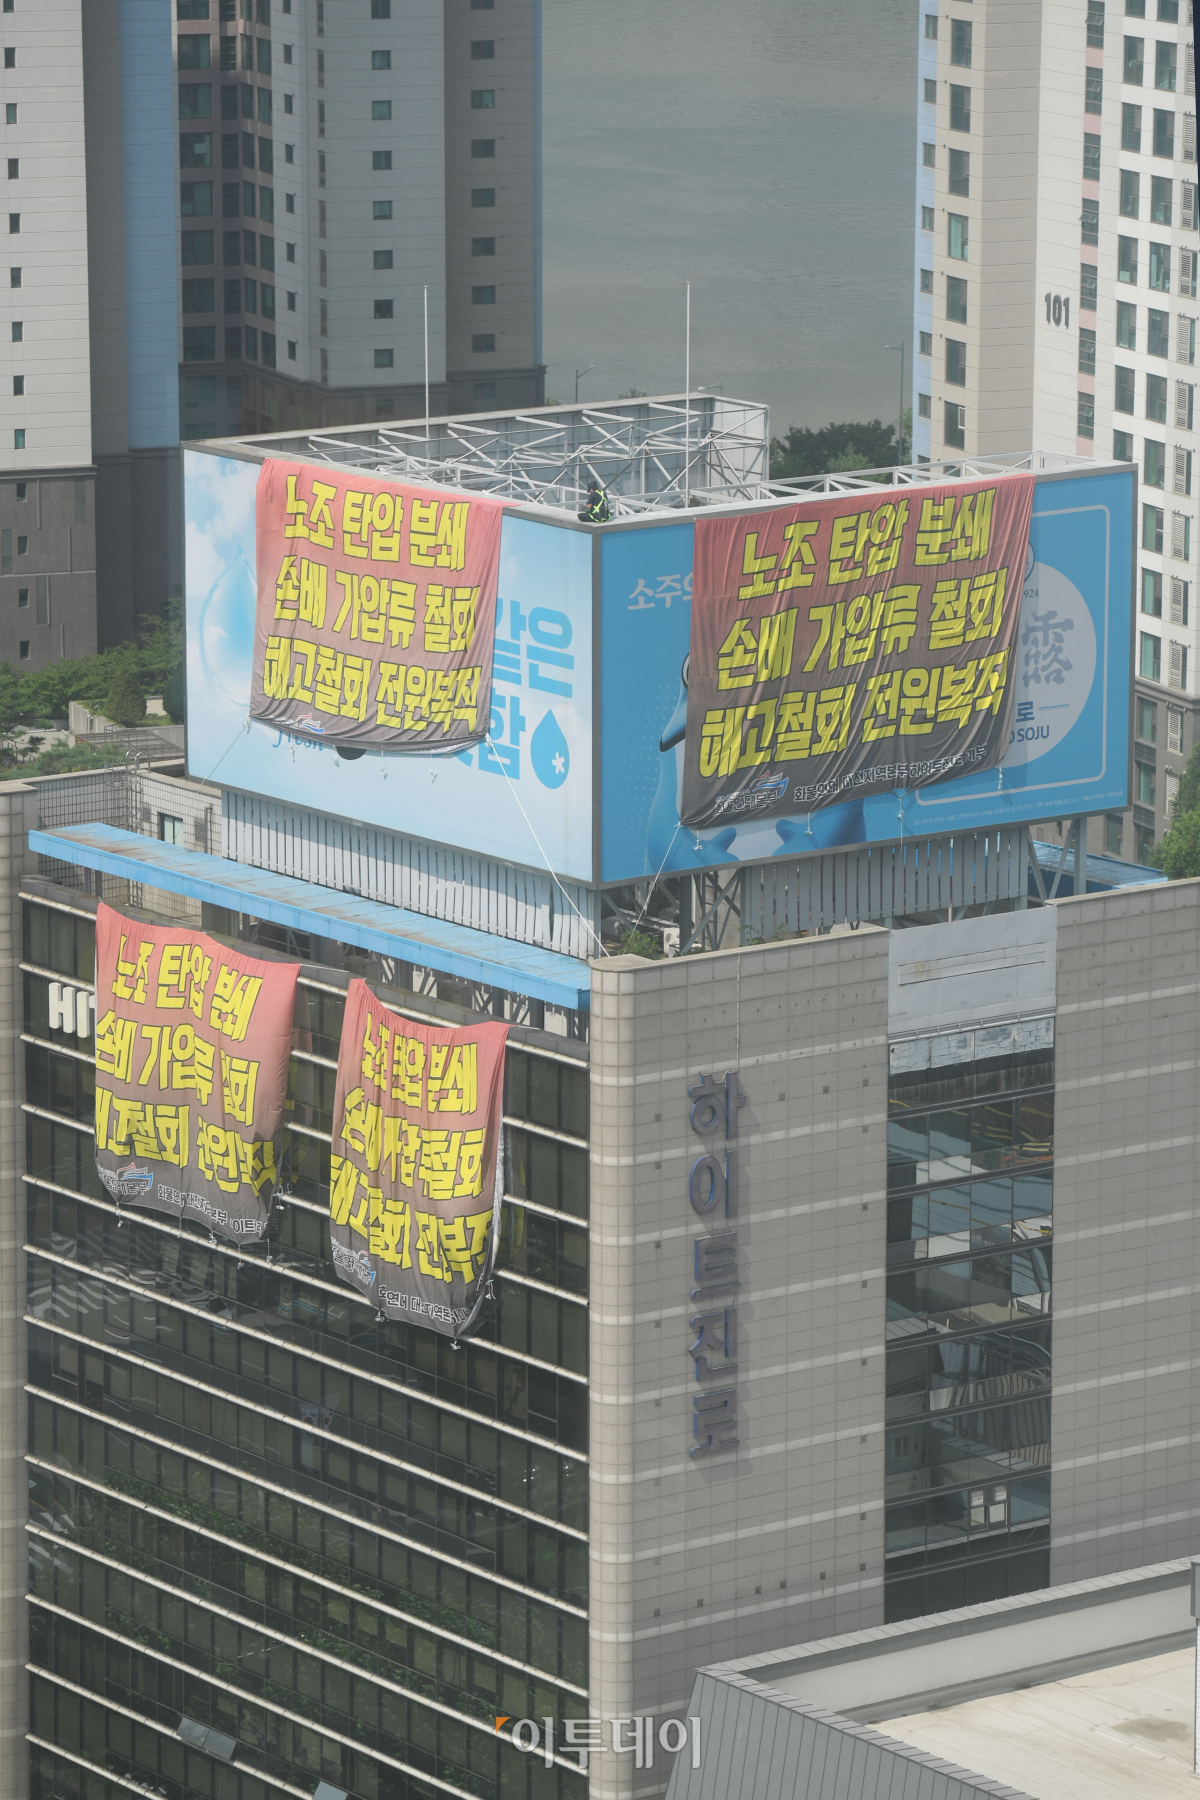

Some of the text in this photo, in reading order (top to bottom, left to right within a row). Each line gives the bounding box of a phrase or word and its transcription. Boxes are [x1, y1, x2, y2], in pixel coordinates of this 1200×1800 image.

[1045, 292, 1070, 329] 101
[285, 475, 470, 572] 노조 탄압 분쇄
[738, 488, 996, 600] 노조 탄압 분쇄
[274, 555, 480, 653] 손배 가압류 철회
[717, 567, 1009, 691] 손배 가압류 철회
[1021, 588, 1040, 599] 924
[263, 635, 372, 723] 해고철회
[699, 645, 1011, 778] 해고철회 전원복직
[111, 934, 155, 1004] 노조
[156, 944, 213, 1020] 탄압
[688, 1070, 747, 1460] 하이트진로
